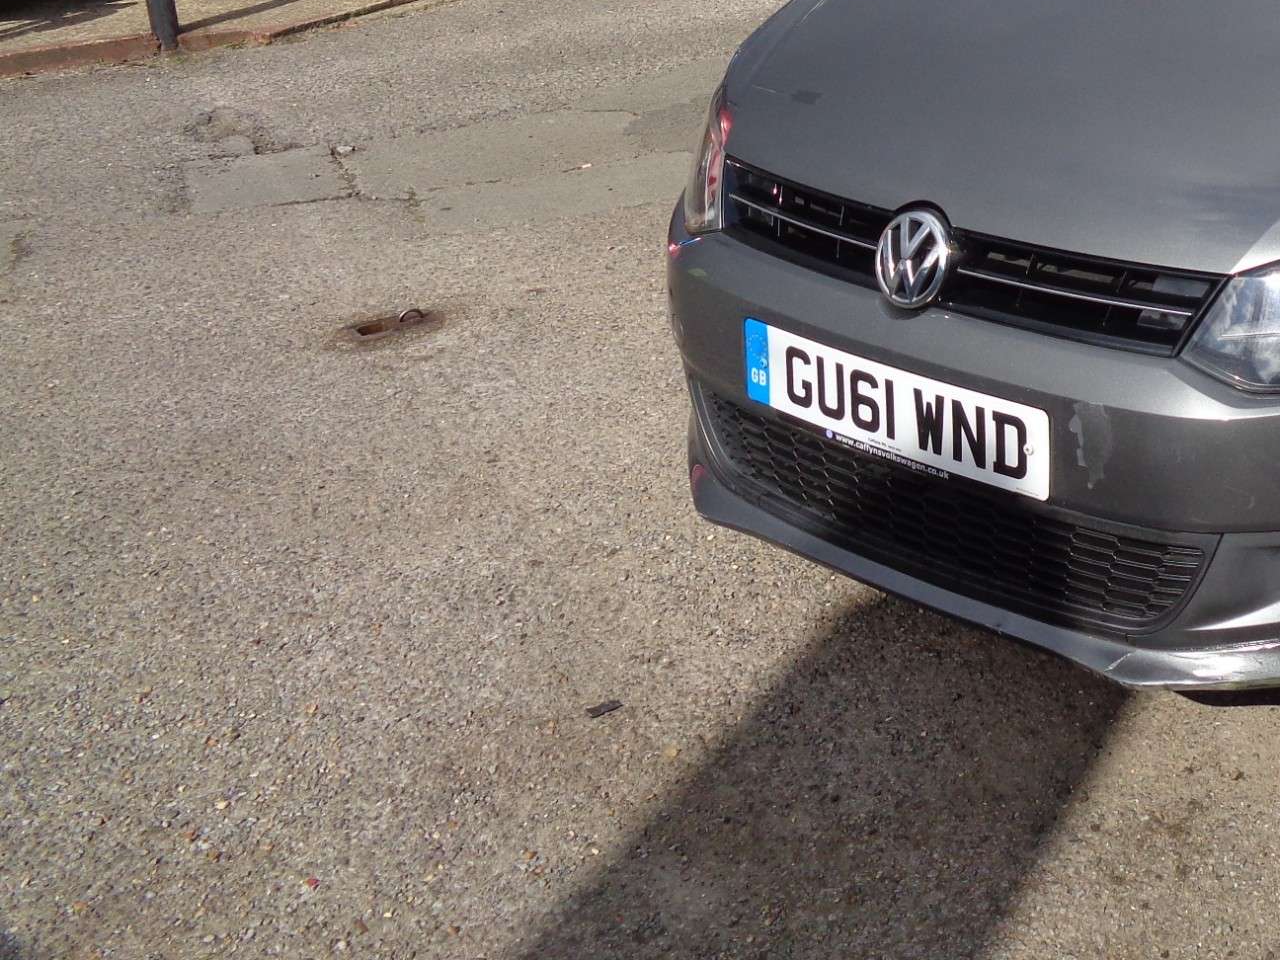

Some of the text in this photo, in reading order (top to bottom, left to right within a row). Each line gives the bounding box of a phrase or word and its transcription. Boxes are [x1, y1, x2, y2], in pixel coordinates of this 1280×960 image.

[751, 366, 767, 387] GB
[785, 345, 1028, 481] GU61 WND
[835, 433, 950, 481] www.caffynsvolkswagen.co.uk
